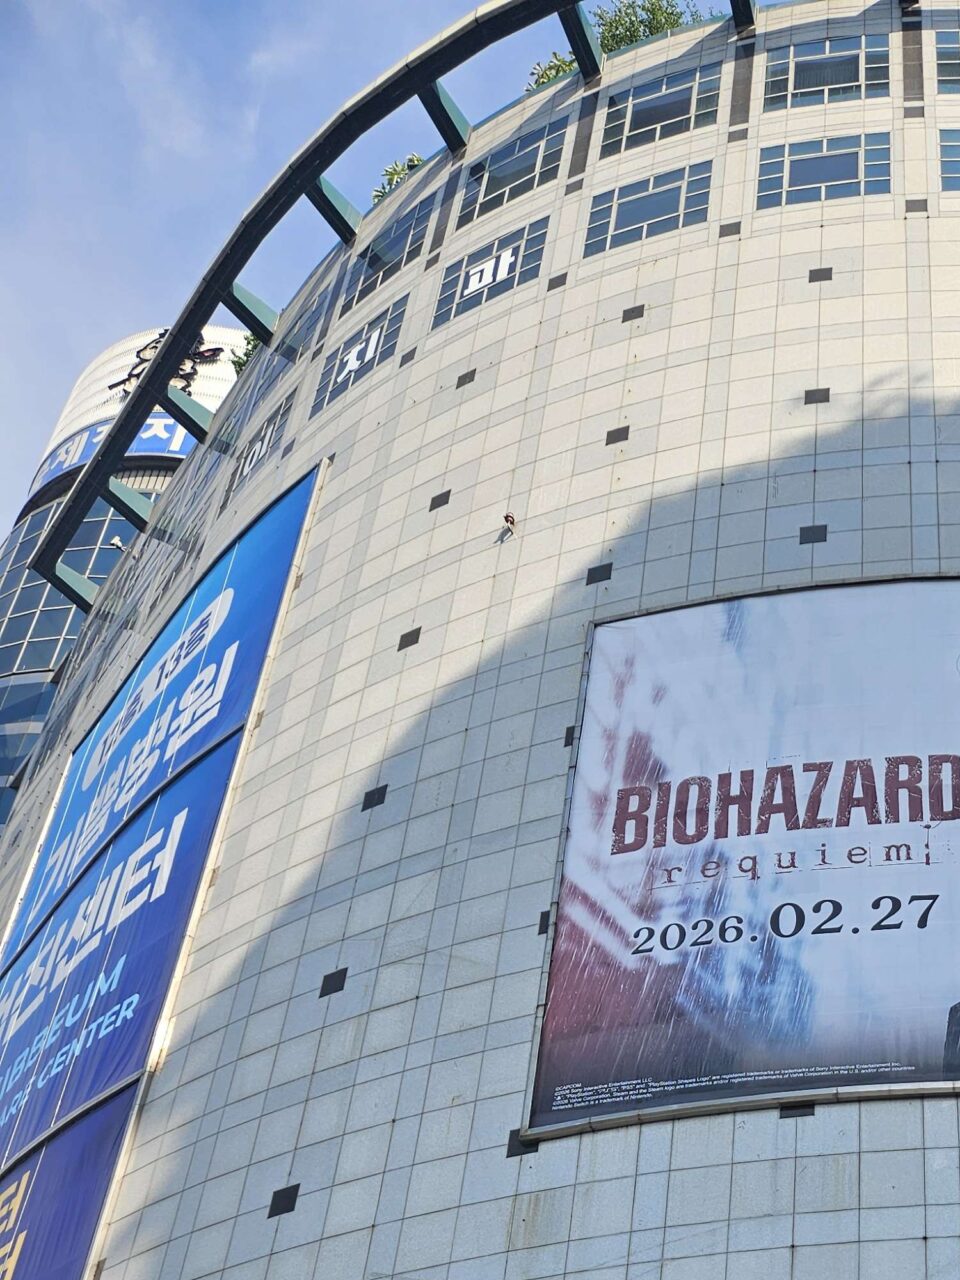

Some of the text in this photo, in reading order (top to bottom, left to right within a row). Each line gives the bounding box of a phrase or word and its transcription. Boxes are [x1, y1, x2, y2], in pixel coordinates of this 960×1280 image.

[631, 894, 940, 956] 2026.02.27
[0, 954, 127, 1098] IBBEUM
[37, 993, 140, 1089] CENTER
